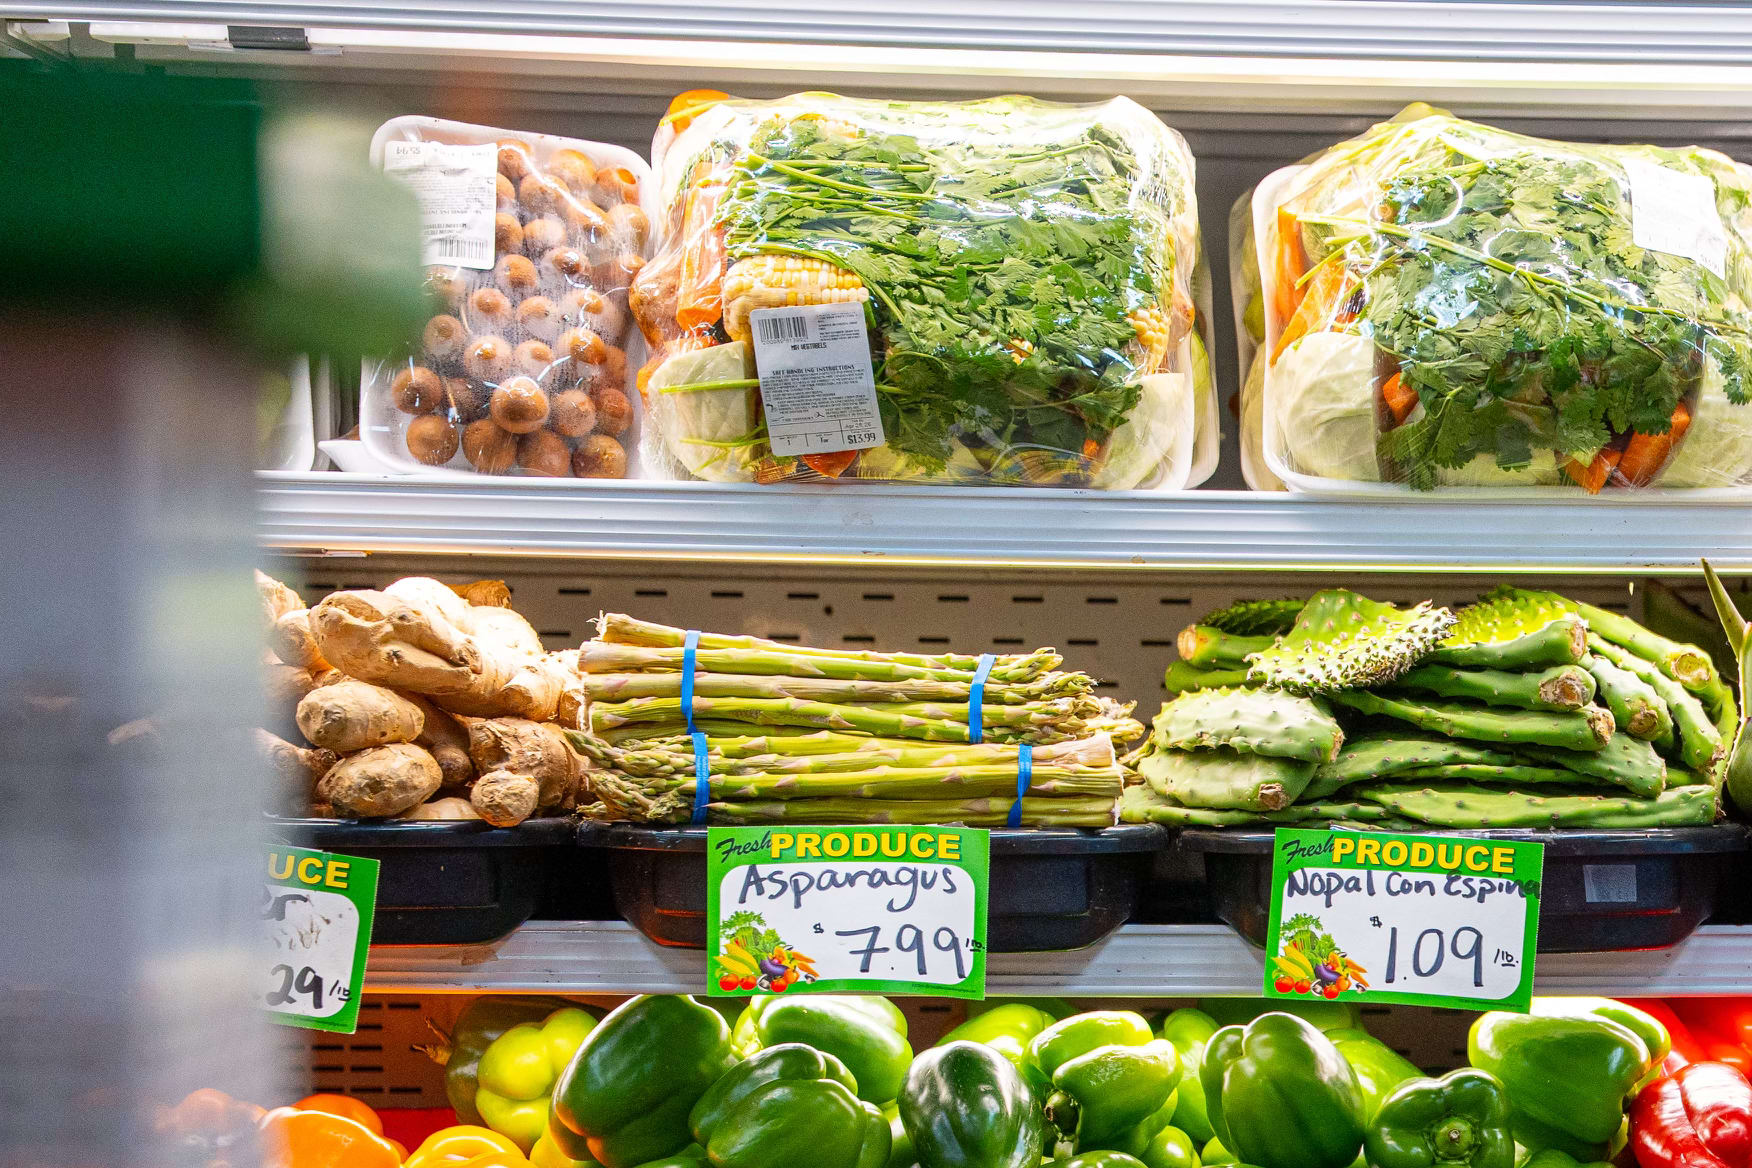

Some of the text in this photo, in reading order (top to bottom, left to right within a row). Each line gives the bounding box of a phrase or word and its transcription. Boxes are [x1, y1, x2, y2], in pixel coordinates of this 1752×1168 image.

[847, 432, 876, 444] $13.99
[716, 831, 961, 863] Fresh PRODUCE
[1282, 834, 1515, 874] Fresh PRODUCE
[738, 863, 957, 912] Asparagus
[1287, 867, 1541, 908] Nopal Con Espina
